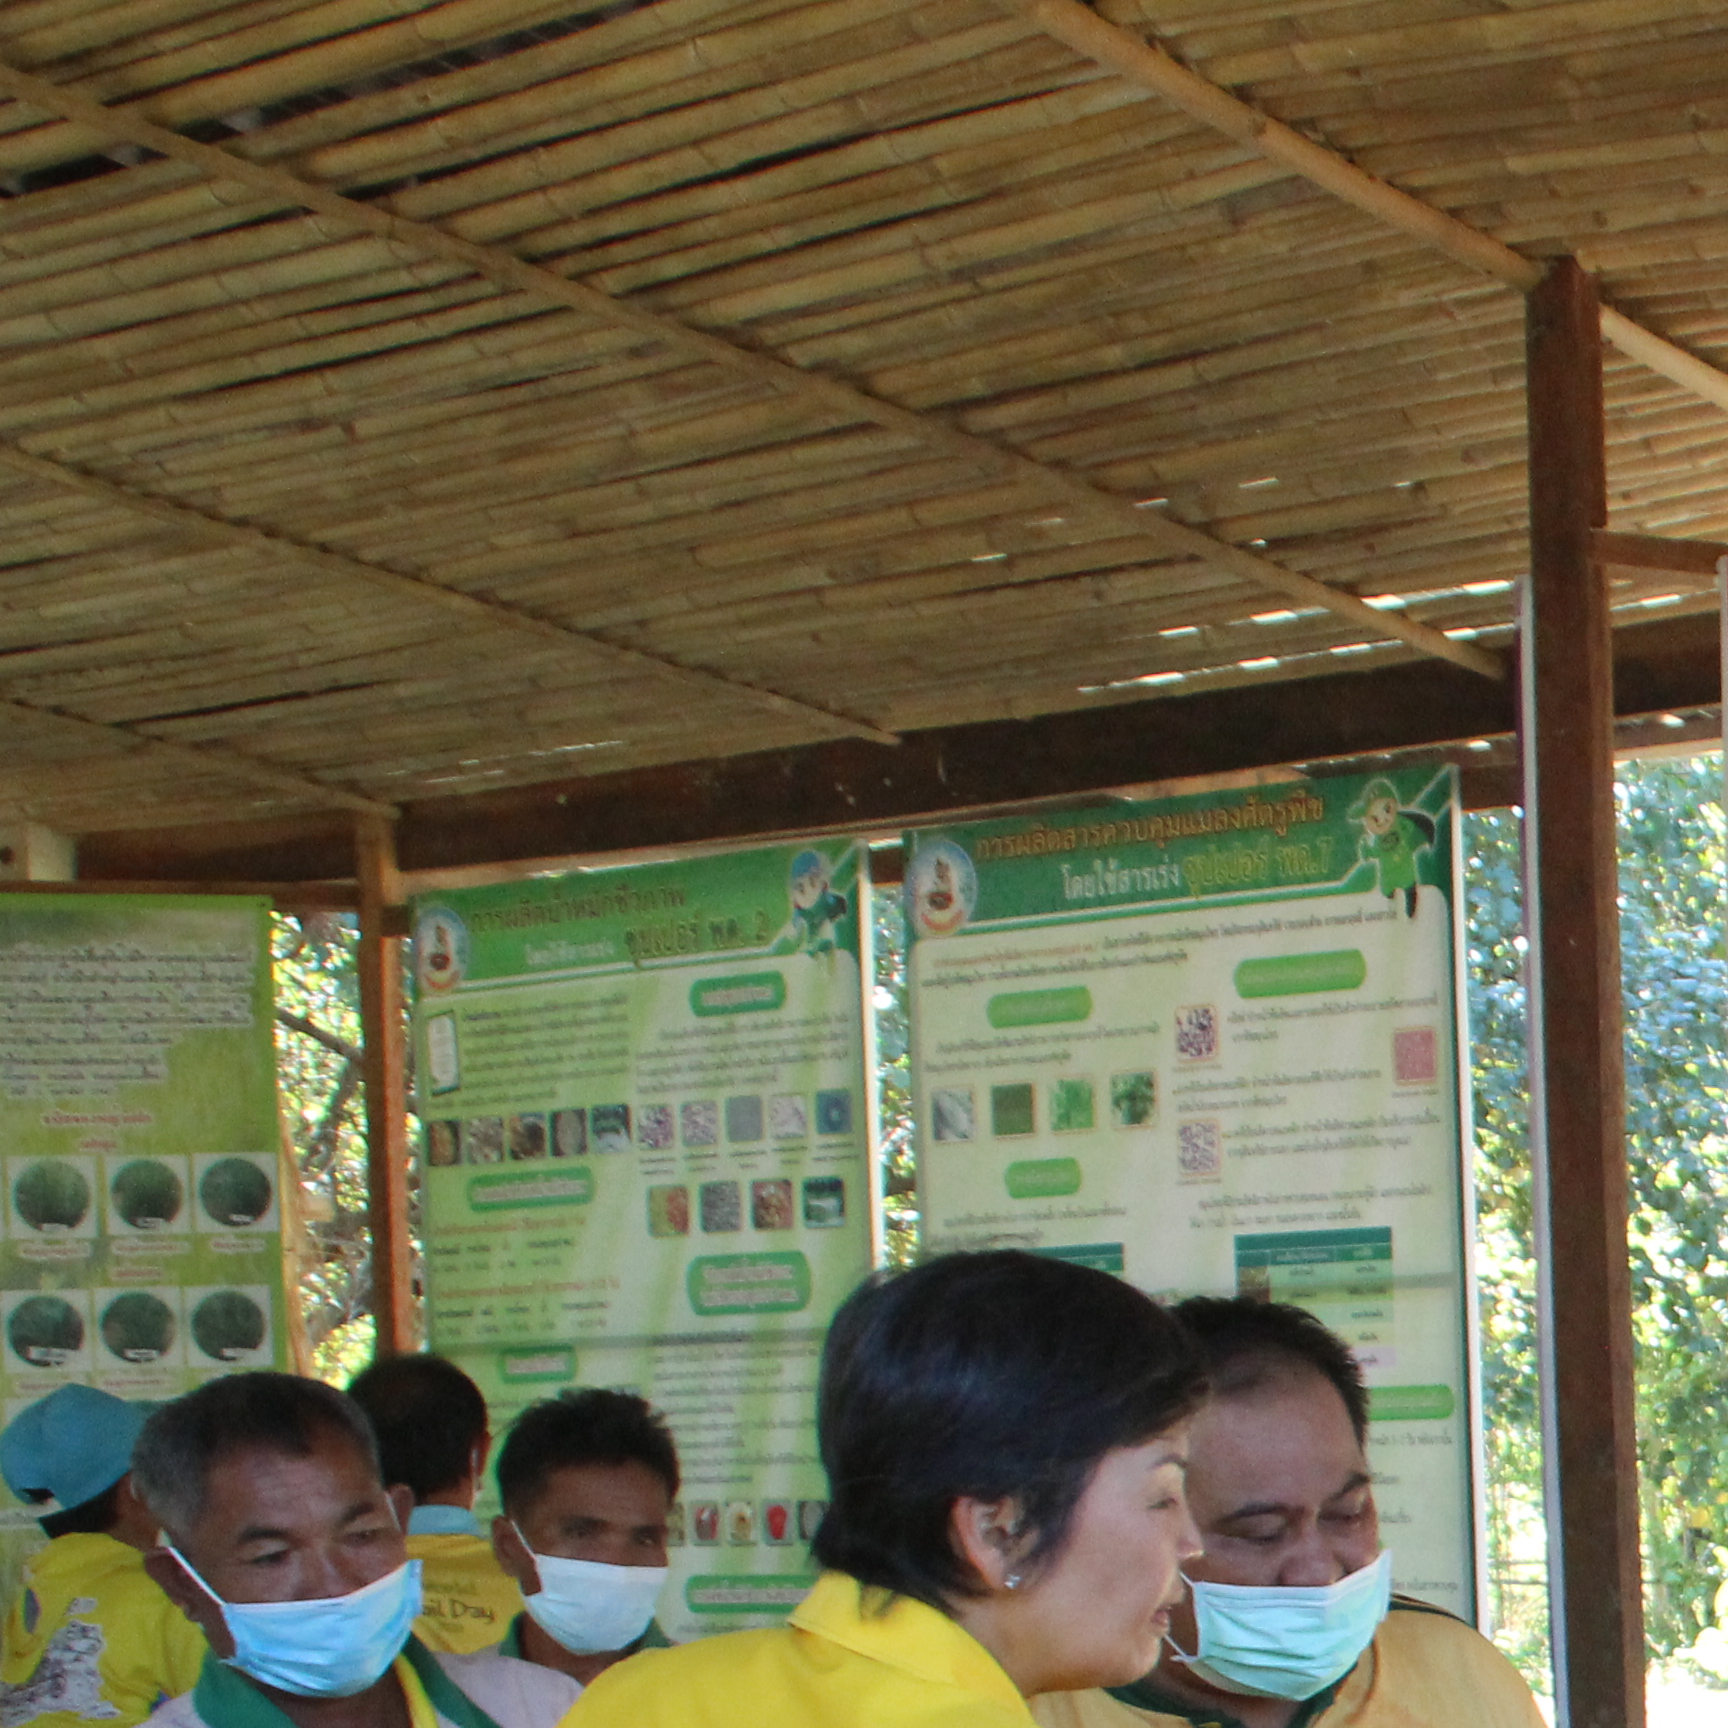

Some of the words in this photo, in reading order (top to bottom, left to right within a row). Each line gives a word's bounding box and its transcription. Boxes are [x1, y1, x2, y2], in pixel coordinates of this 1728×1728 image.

[1061, 854, 1181, 900] โดยใช้สารเร่ง
[449, 1599, 495, 1624] Day
